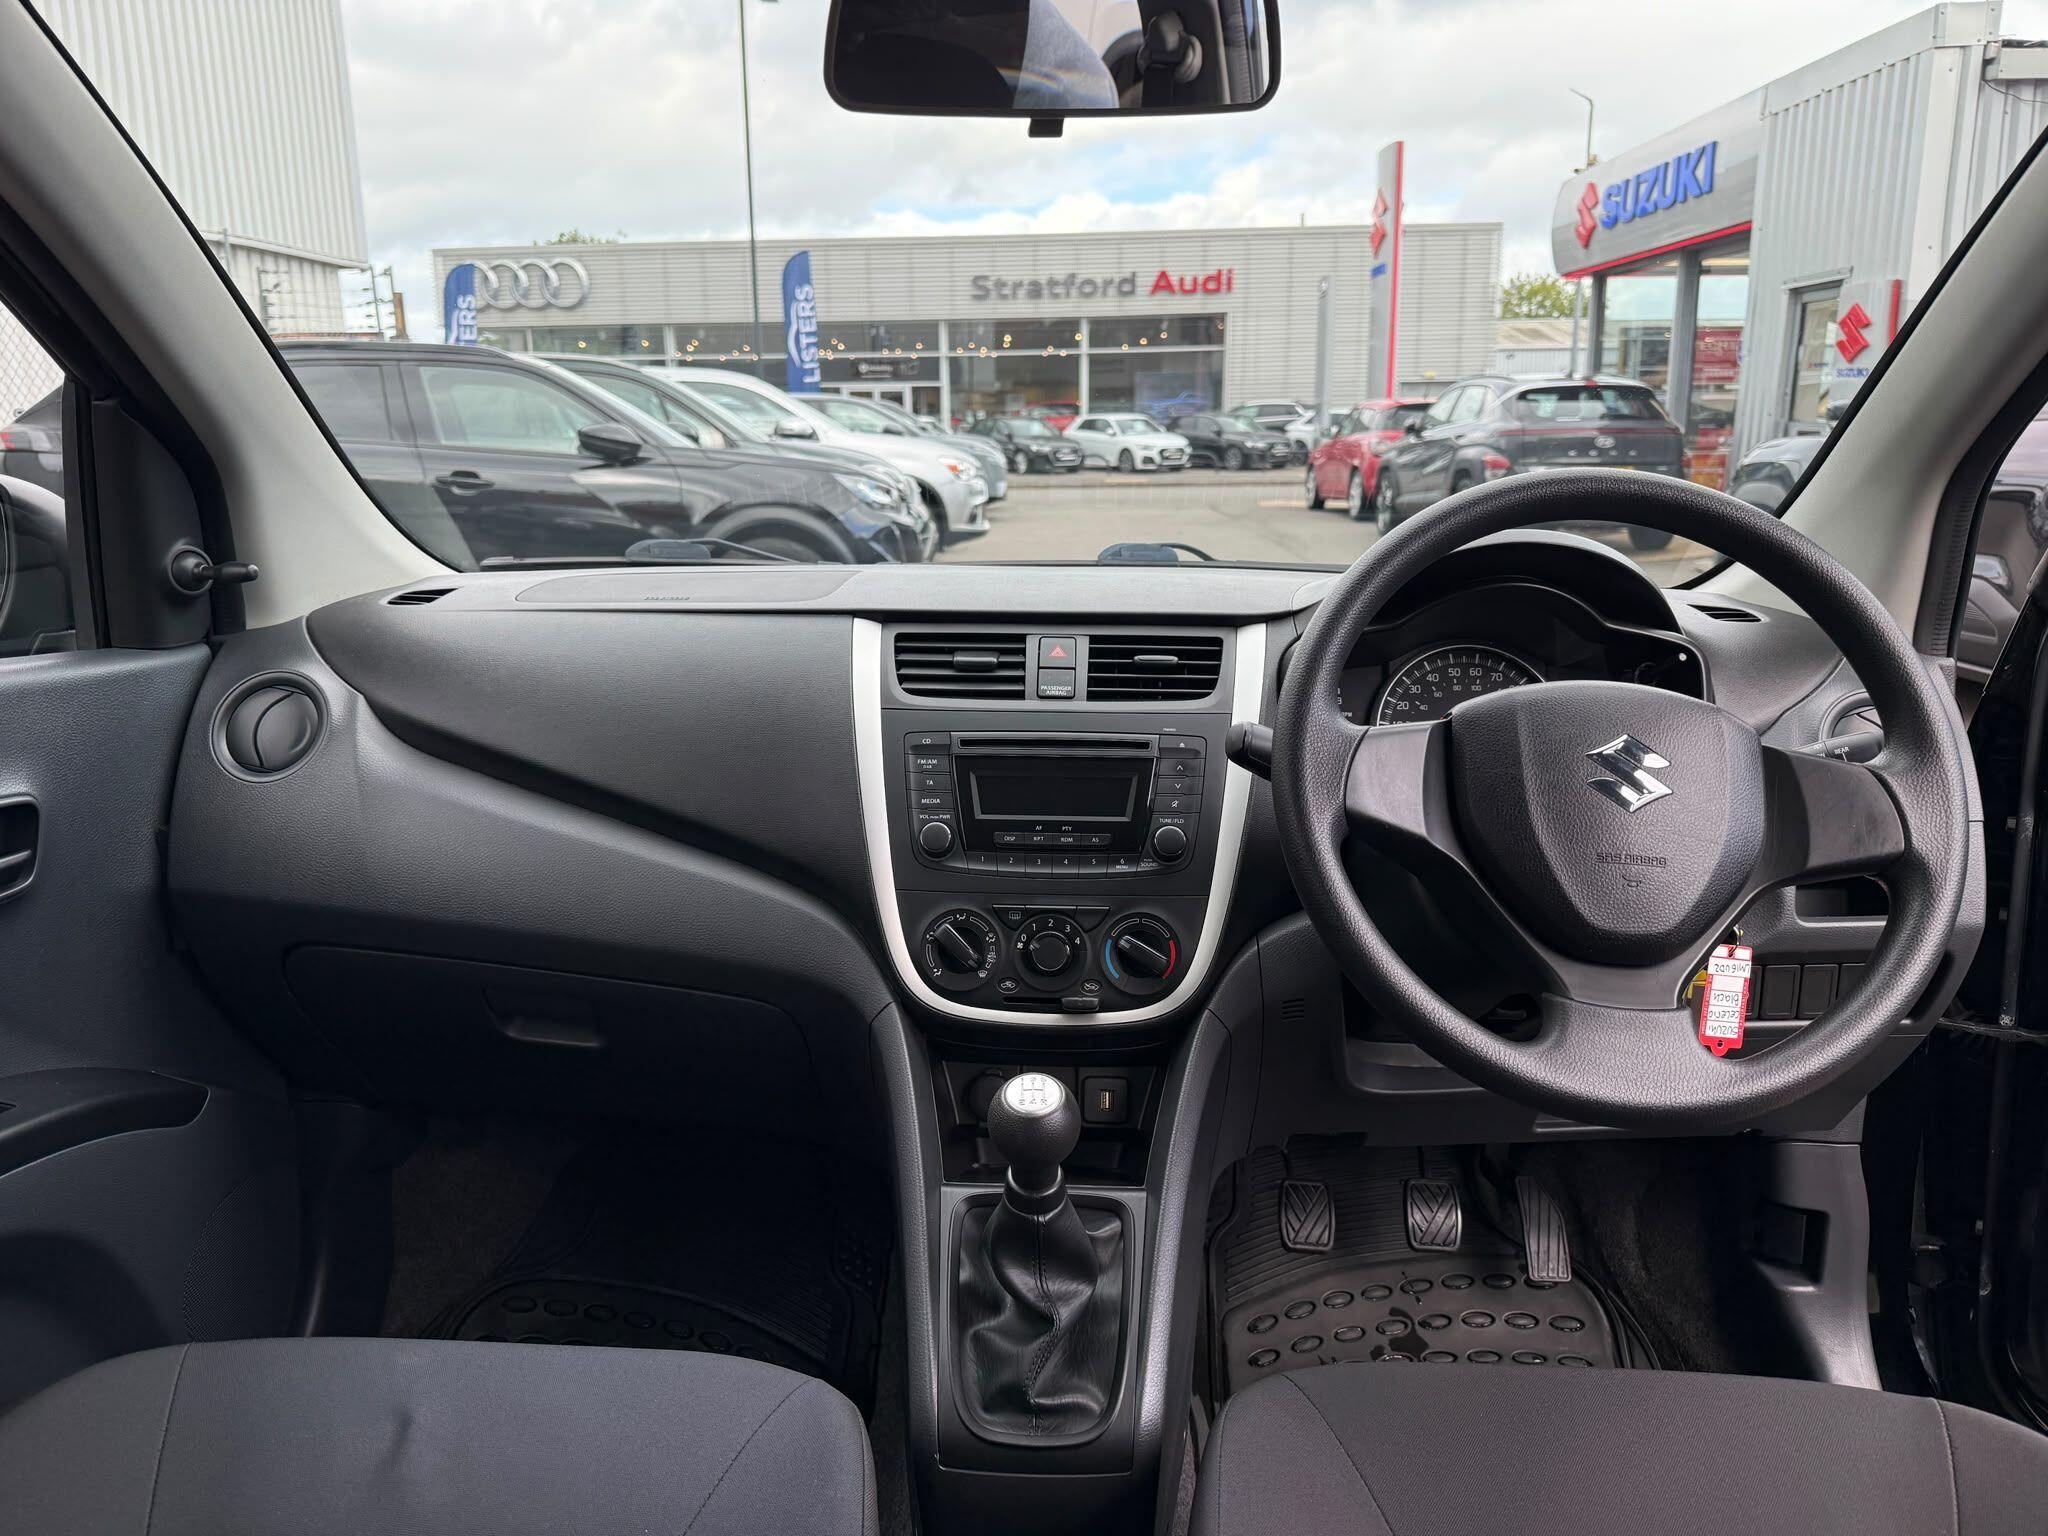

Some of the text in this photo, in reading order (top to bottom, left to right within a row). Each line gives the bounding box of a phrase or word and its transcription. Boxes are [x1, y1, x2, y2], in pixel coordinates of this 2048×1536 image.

[1600, 141, 1718, 230] SUZUKI
[971, 267, 1235, 300] Stratford Audi
[795, 283, 822, 383] LISTERS
[1448, 667, 1461, 677] 50
[1469, 667, 1482, 676] 60
[1426, 673, 1439, 682] 40
[1490, 672, 1503, 682] 70
[1408, 685, 1421, 694] 30
[1396, 701, 1409, 710] 20
[1834, 746, 1850, 755] REAR
[1596, 852, 1667, 866] SRS AIRBAG
[1032, 923, 1036, 931] 1
[1048, 918, 1054, 927] 2
[1065, 924, 1071, 933] 3
[1020, 934, 1027, 942] 0
[1074, 937, 1081, 945] 4
